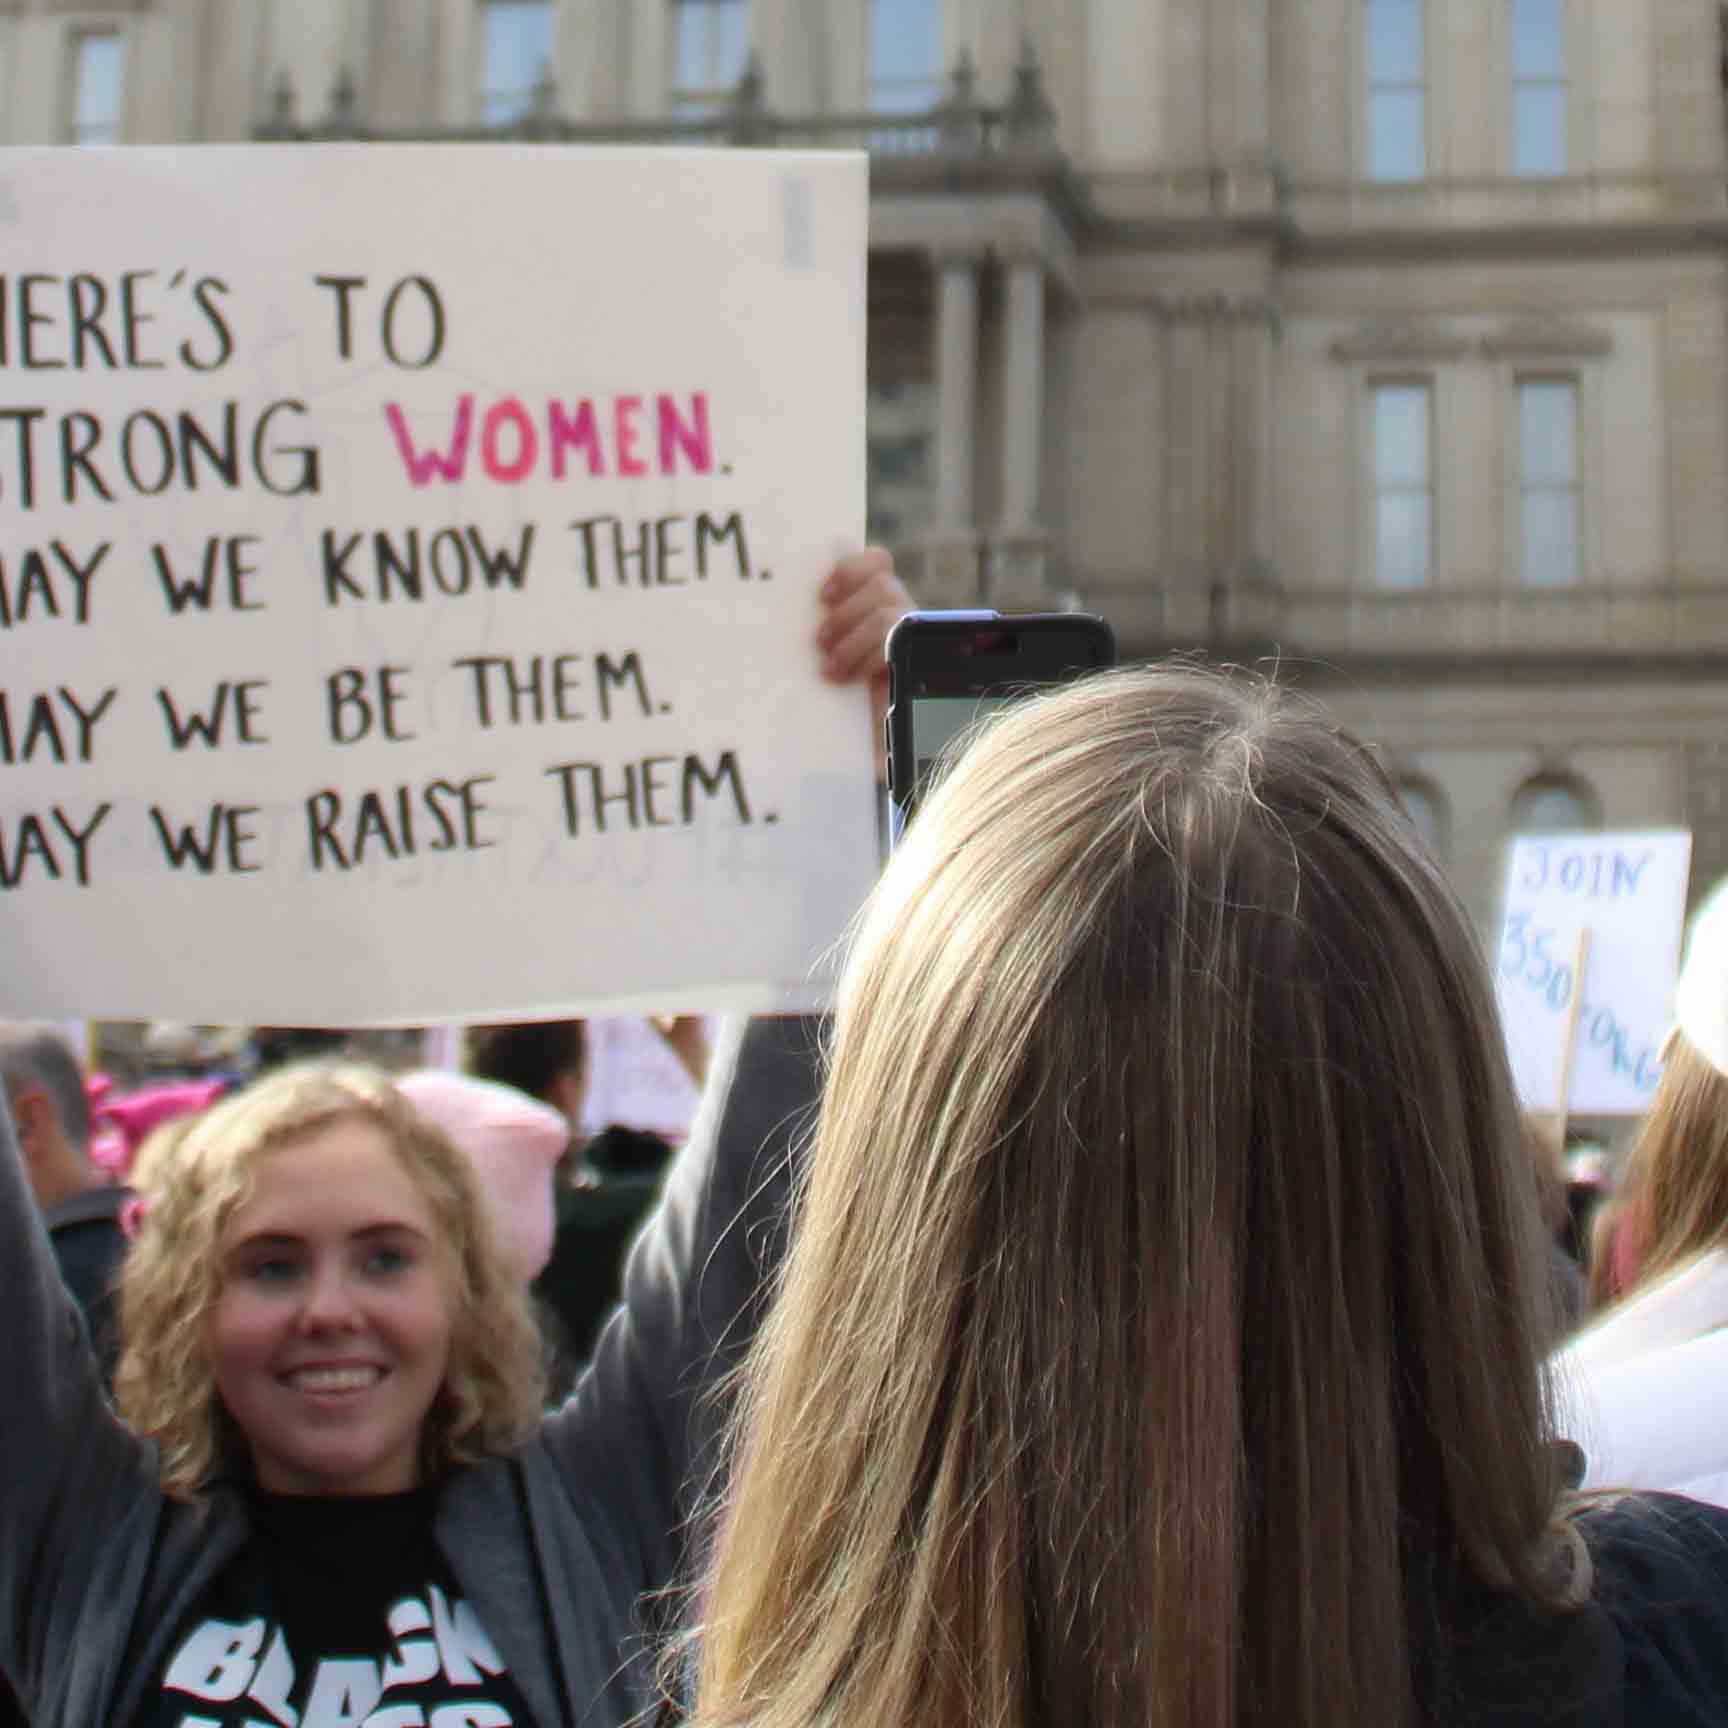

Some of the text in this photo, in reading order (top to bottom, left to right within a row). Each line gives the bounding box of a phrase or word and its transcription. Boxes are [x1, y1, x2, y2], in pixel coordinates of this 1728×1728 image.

[314, 274, 447, 368] TO
[384, 391, 732, 488] WOMEN.
[154, 534, 267, 615] WE
[322, 520, 538, 609] KNOW
[569, 510, 774, 592] THEM.
[157, 678, 272, 750] WE
[326, 664, 418, 746] BE
[452, 648, 674, 730] THEM.
[150, 802, 264, 875] WE
[305, 776, 498, 872] RAISE
[542, 748, 780, 838] THEM.
[1522, 842, 1654, 900] JOIN
[160, 1584, 508, 1728] BLACK
